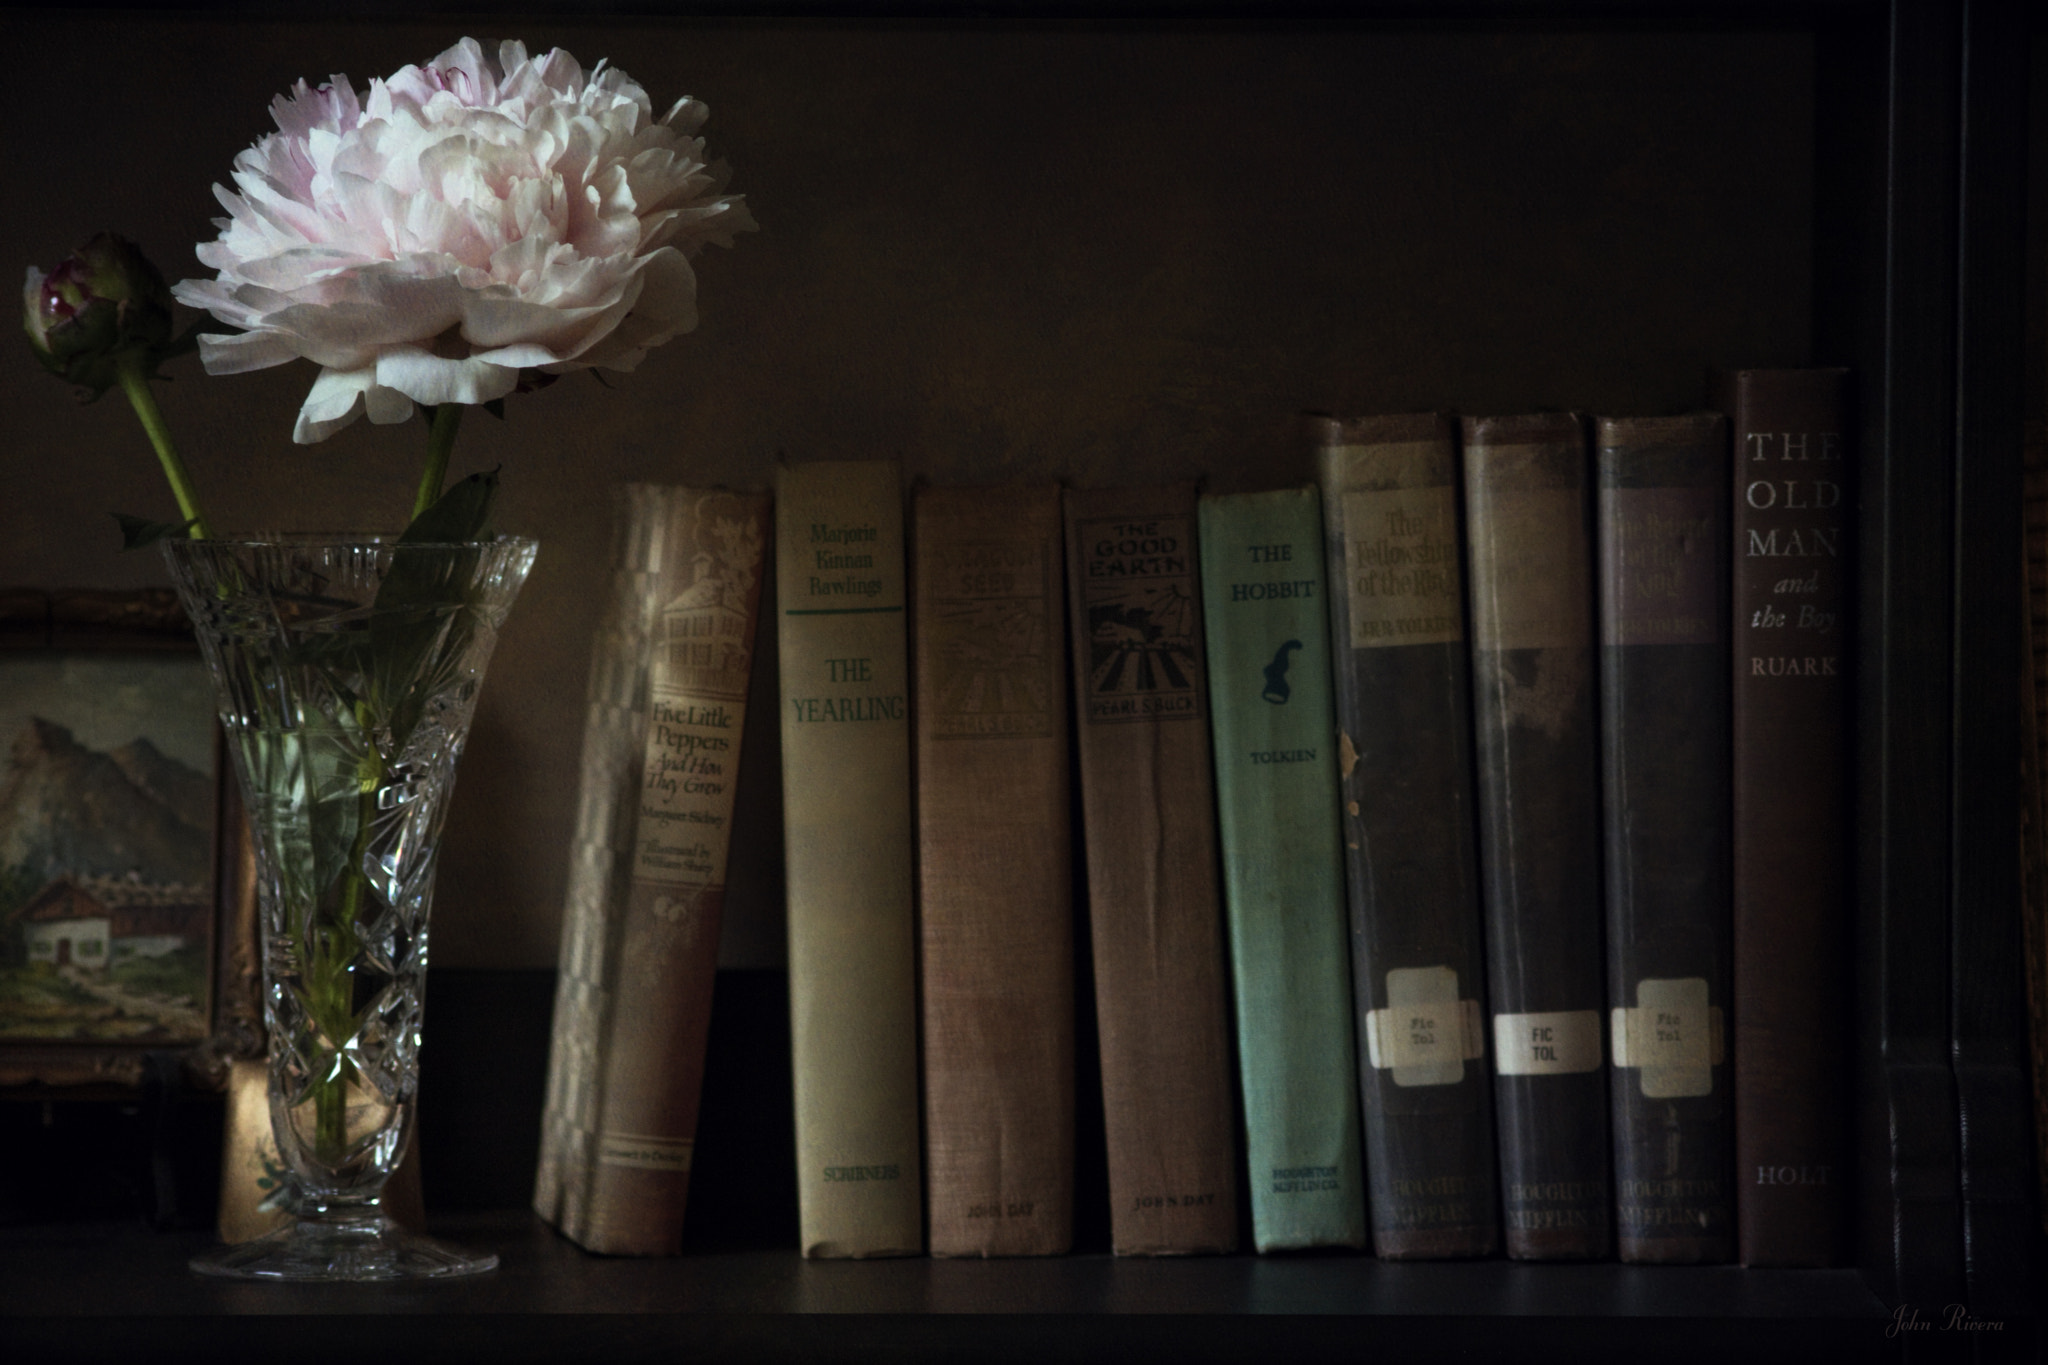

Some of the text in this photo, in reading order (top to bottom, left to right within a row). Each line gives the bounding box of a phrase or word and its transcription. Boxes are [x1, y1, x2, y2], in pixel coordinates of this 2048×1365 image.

[1746, 432, 1840, 461] THE
[1746, 480, 1841, 510] OLD
[811, 523, 877, 547] Marjorie
[1113, 522, 1159, 537] THE
[1095, 537, 1178, 557] GOOD
[1249, 544, 1293, 563] THE
[1746, 528, 1840, 557] MAN
[816, 550, 874, 569] Kinnan
[1089, 557, 1185, 578] EARTH
[810, 576, 883, 598] Rawlings
[1231, 580, 1316, 602] HOBBIT
[1357, 569, 1378, 596] of
[1381, 567, 1411, 596] the
[1773, 569, 1820, 594] and
[1750, 603, 1837, 635] the Boy
[825, 658, 873, 682] THE
[1751, 656, 1838, 677] RUARK
[653, 702, 732, 729] Five Little
[792, 696, 905, 722] YEARLING
[1093, 699, 1138, 715] PEARL
[656, 724, 730, 755] Peppers
[1250, 749, 1317, 765] TOLKIEN
[1532, 1026, 1553, 1042] FIC
[1532, 1045, 1557, 1061] TOL
[1756, 1164, 1831, 1186] HOLT
[1006, 1203, 1034, 1218] DAY
[1134, 1194, 1216, 1210] JOHN DAY
